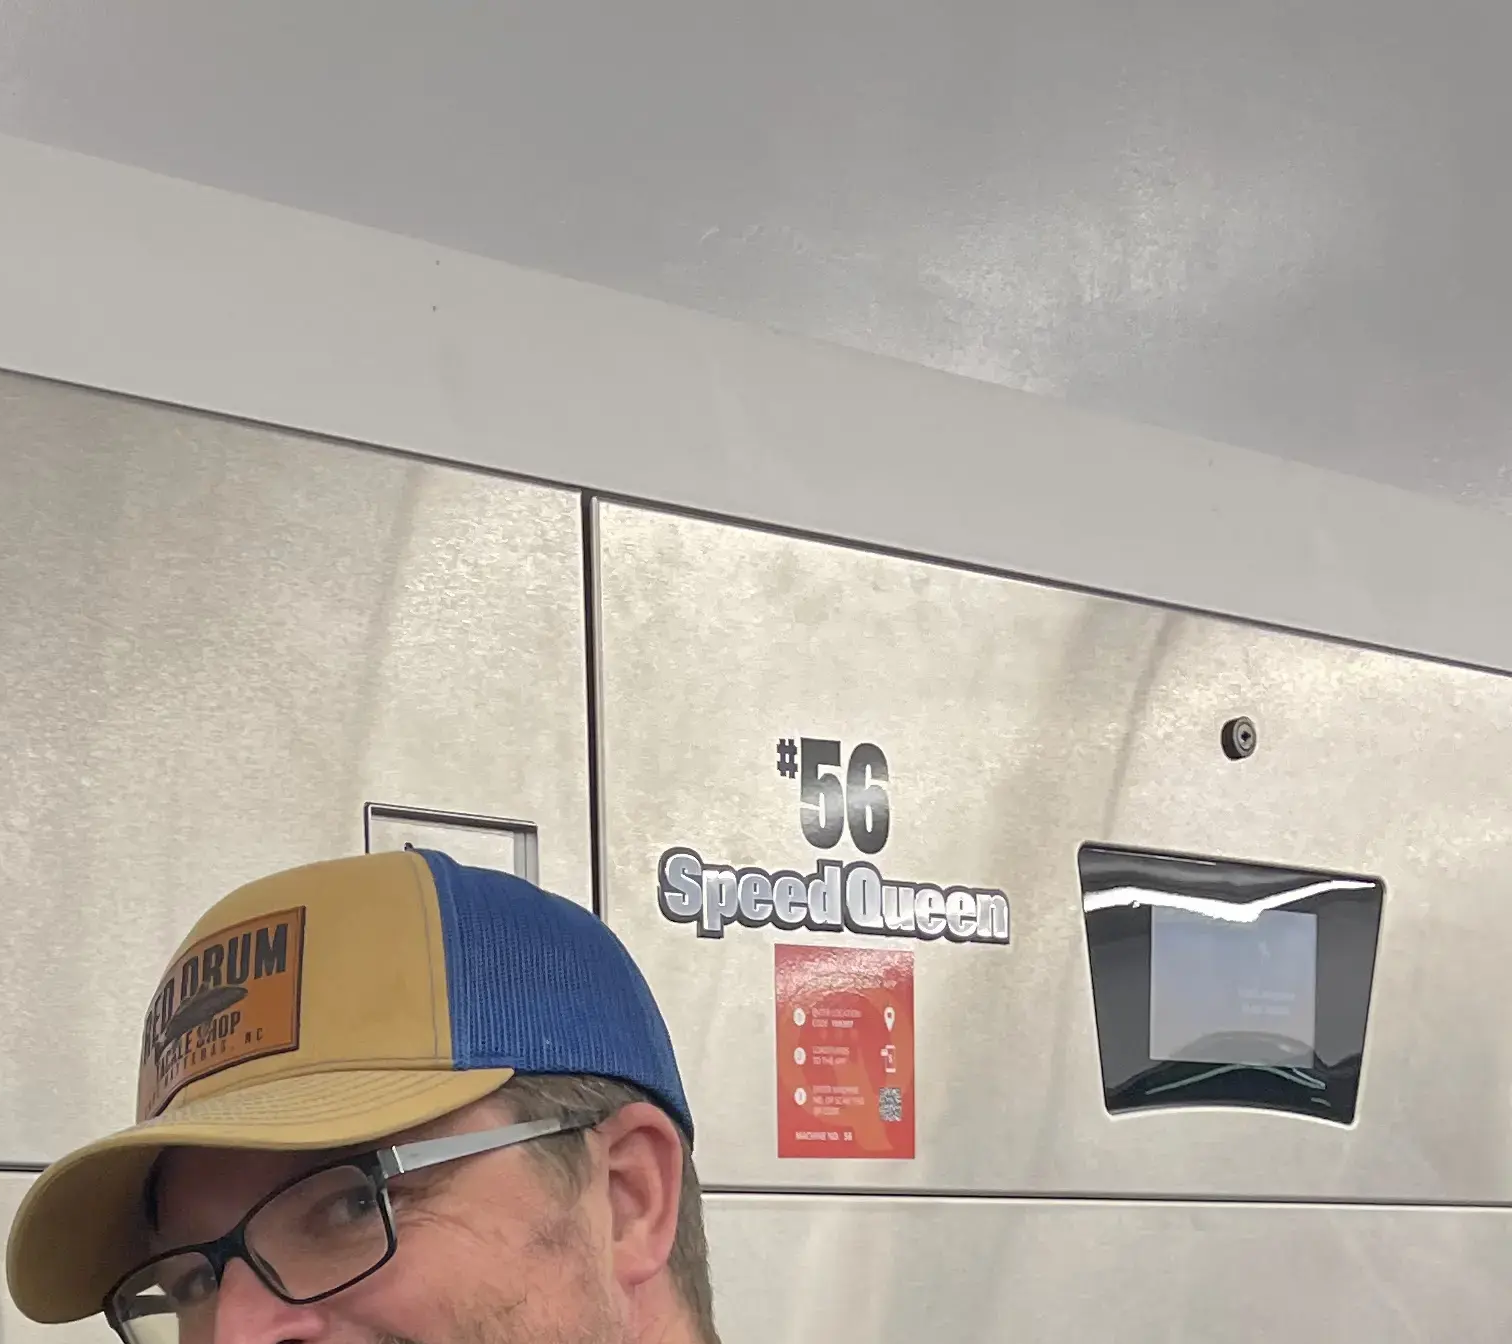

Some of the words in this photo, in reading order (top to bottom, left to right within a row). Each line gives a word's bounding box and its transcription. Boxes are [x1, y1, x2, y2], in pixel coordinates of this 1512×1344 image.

[777, 738, 889, 854] #56
[180, 923, 288, 1001] DRUM
[196, 1011, 241, 1048] SHOP
